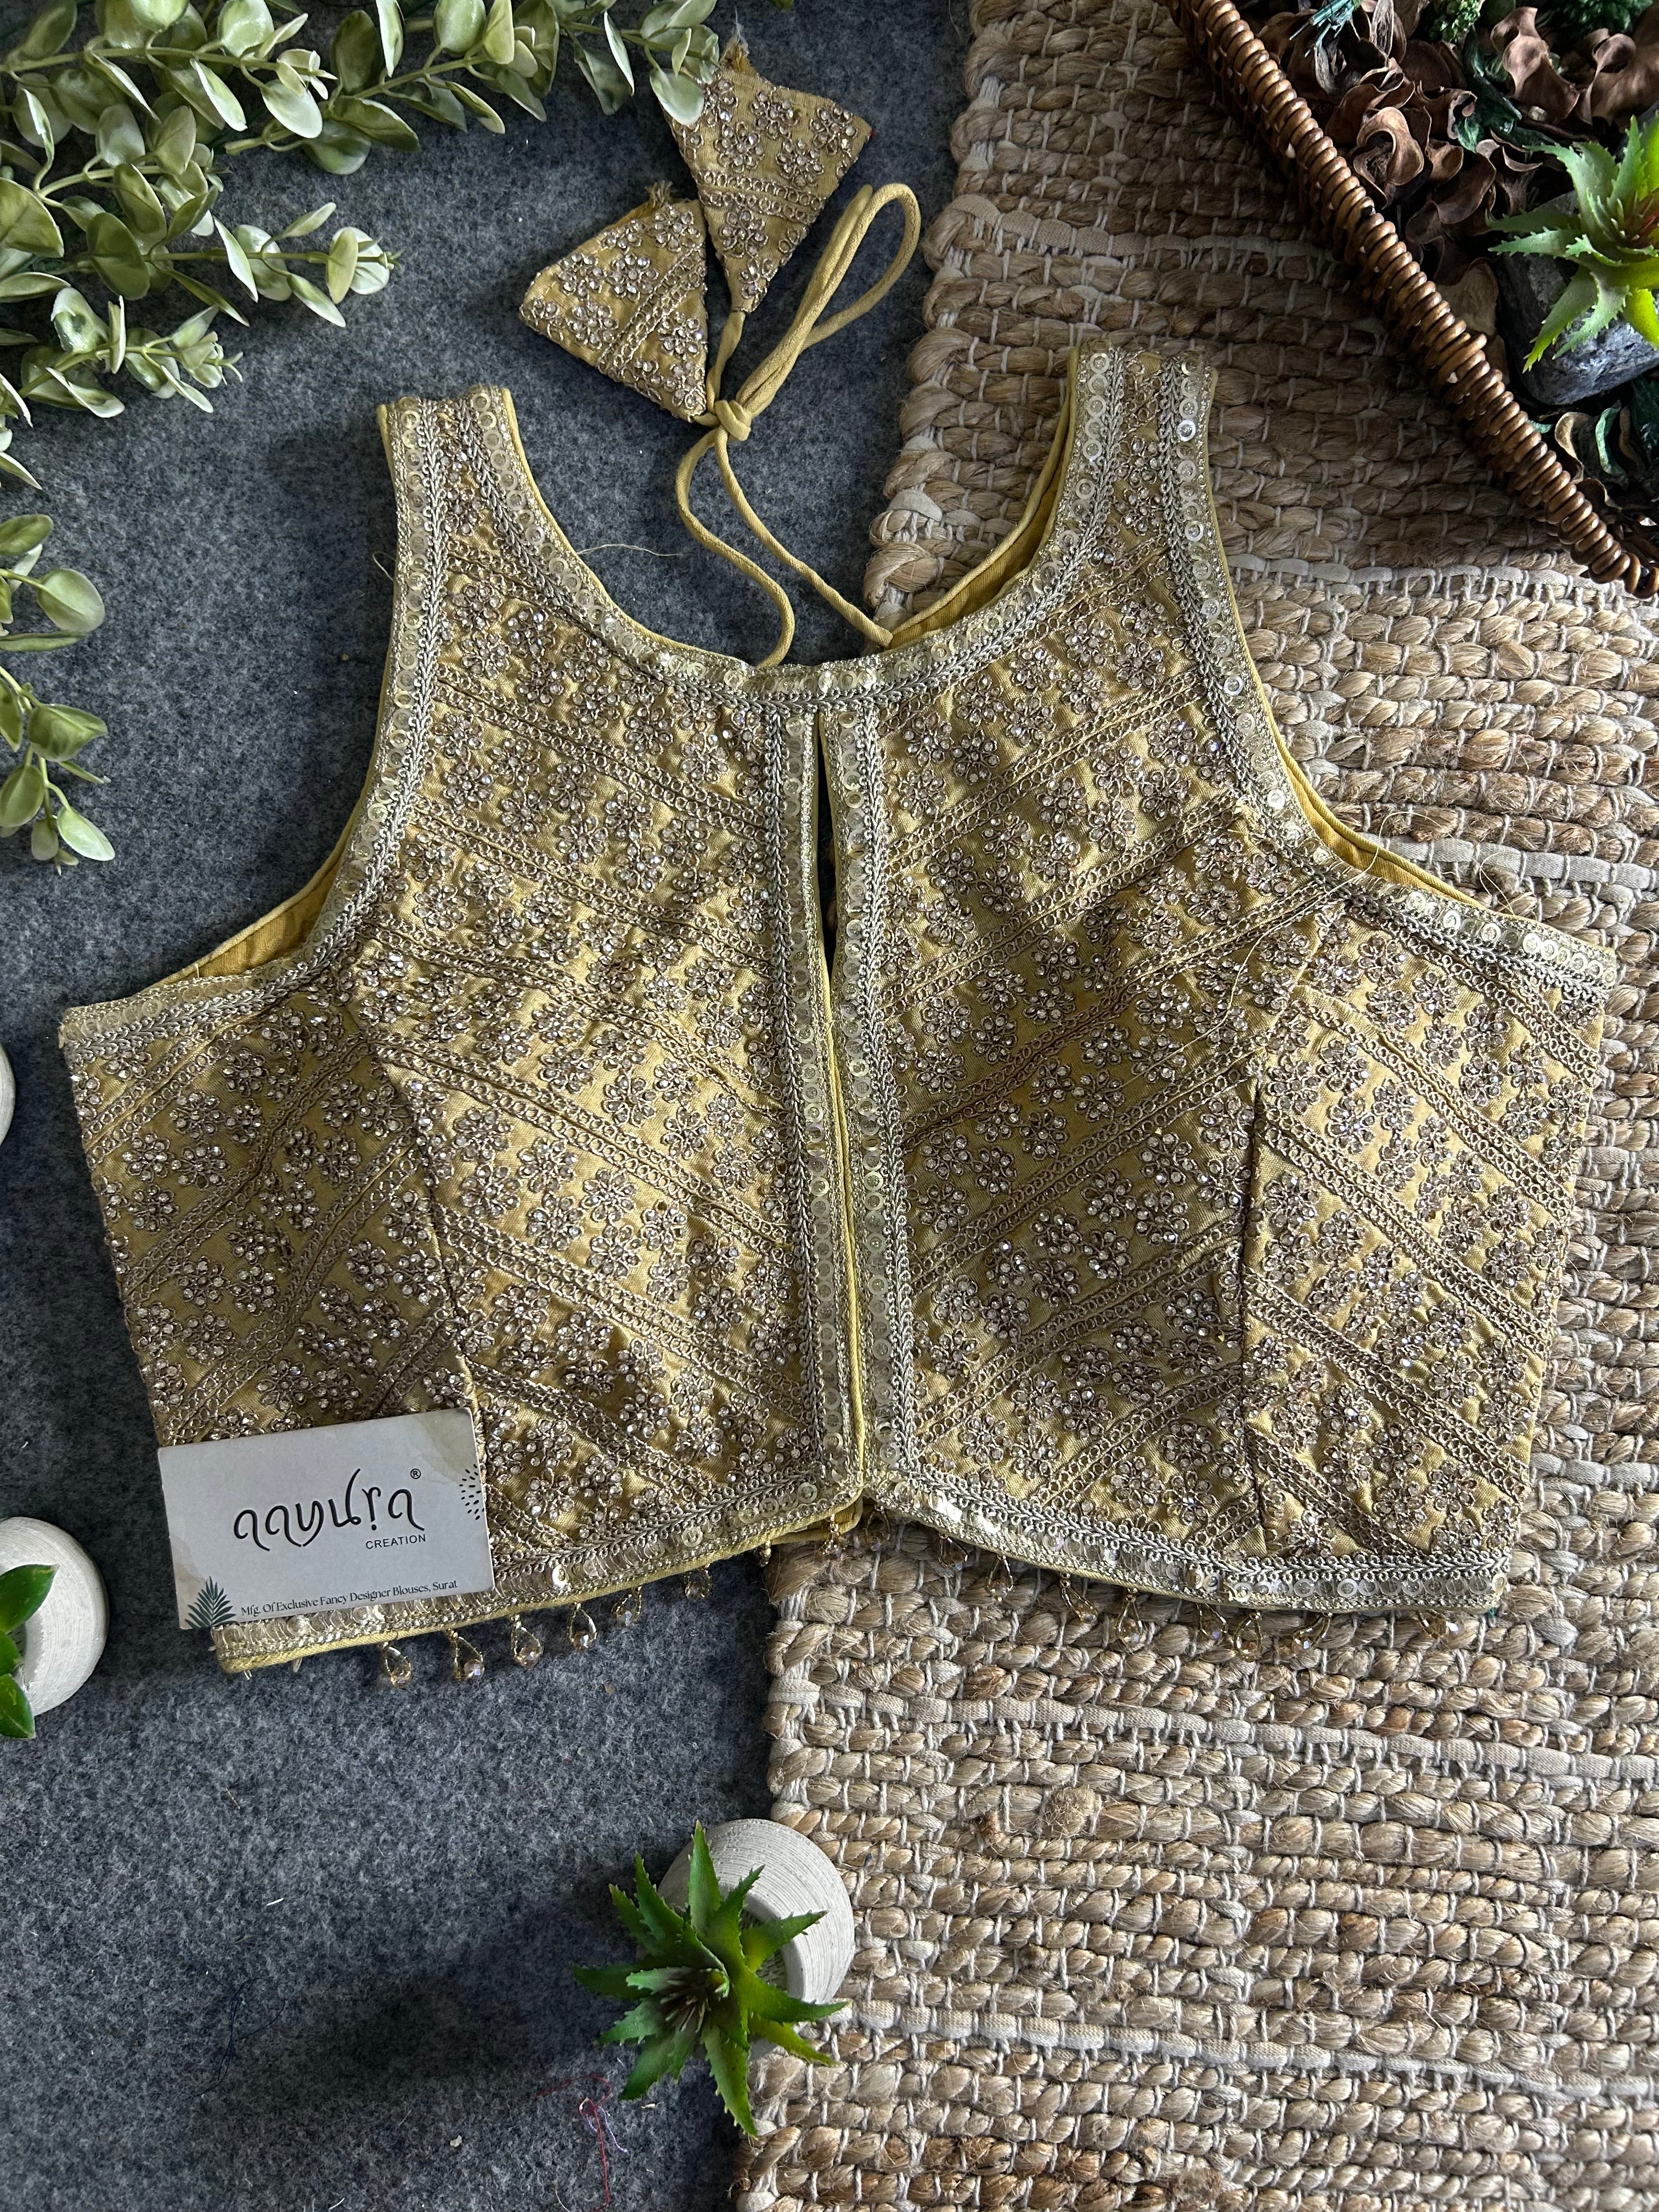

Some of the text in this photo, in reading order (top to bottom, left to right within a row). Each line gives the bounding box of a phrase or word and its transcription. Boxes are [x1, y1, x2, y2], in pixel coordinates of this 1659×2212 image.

[366, 1534, 426, 1549] CREATION
[241, 1581, 458, 1617] Mfg. Of Exclusive Fancy Designer Blouses, Surat
